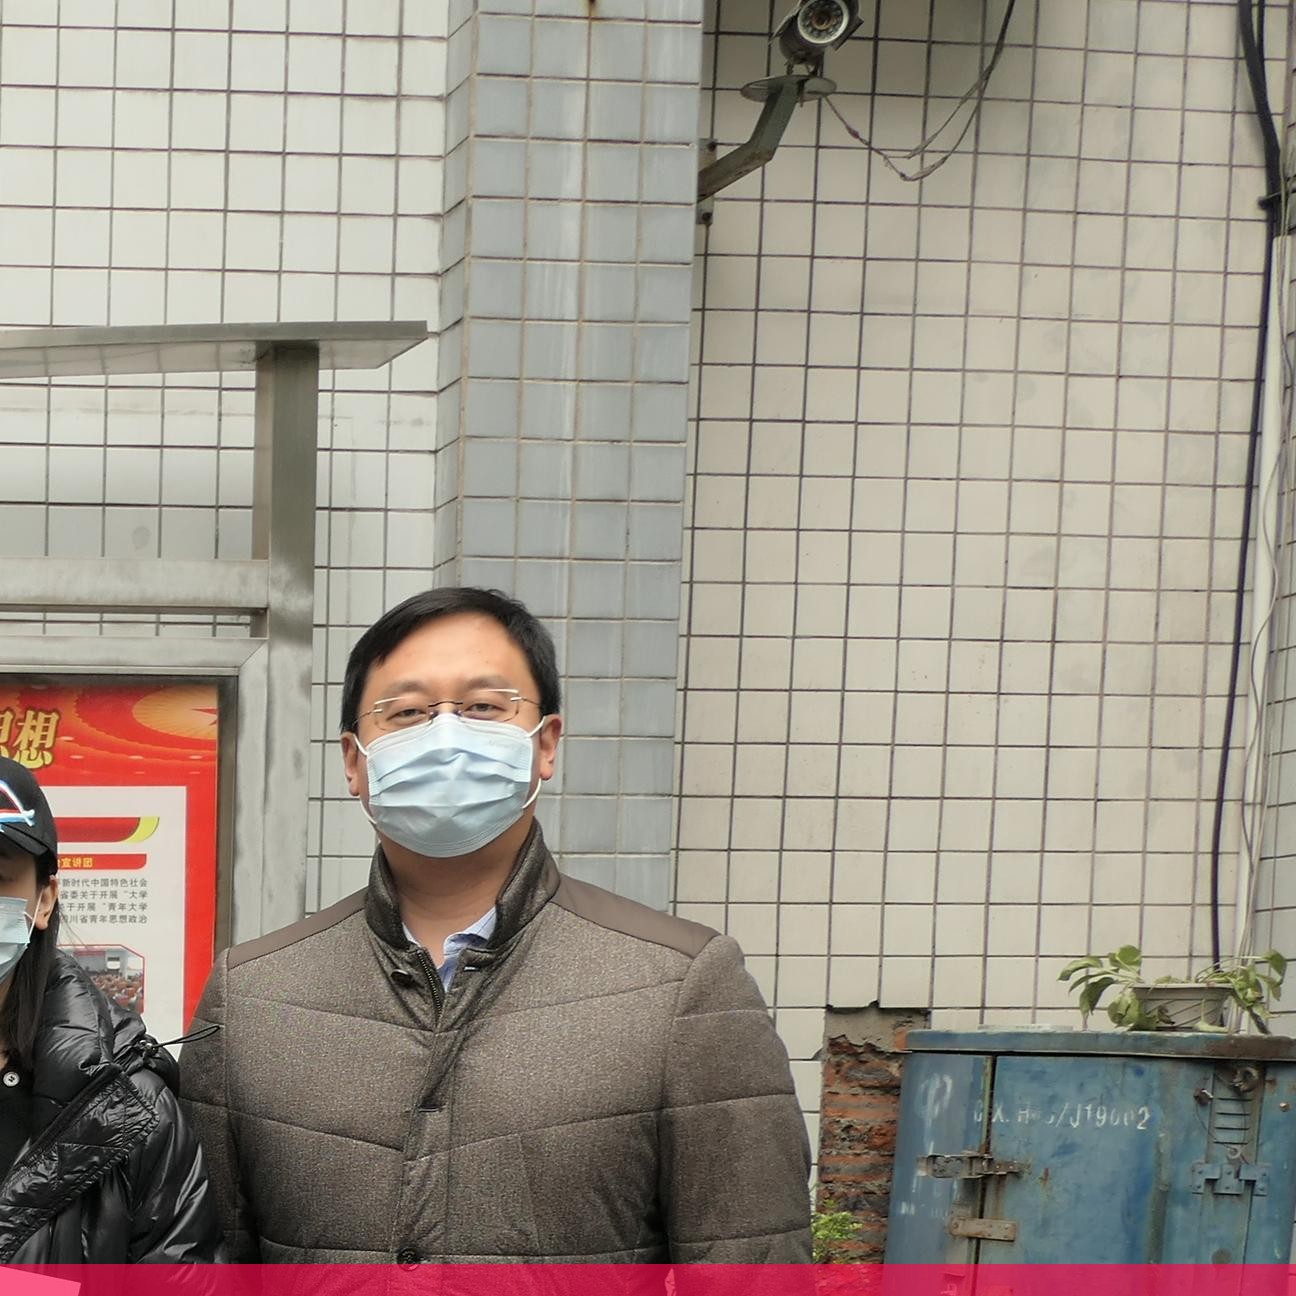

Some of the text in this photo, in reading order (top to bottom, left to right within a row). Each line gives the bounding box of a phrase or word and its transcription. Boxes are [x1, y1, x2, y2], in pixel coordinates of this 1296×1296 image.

[58, 857, 94, 868] 宣讲团
[58, 878, 147, 888] 新时代中国特色社会
